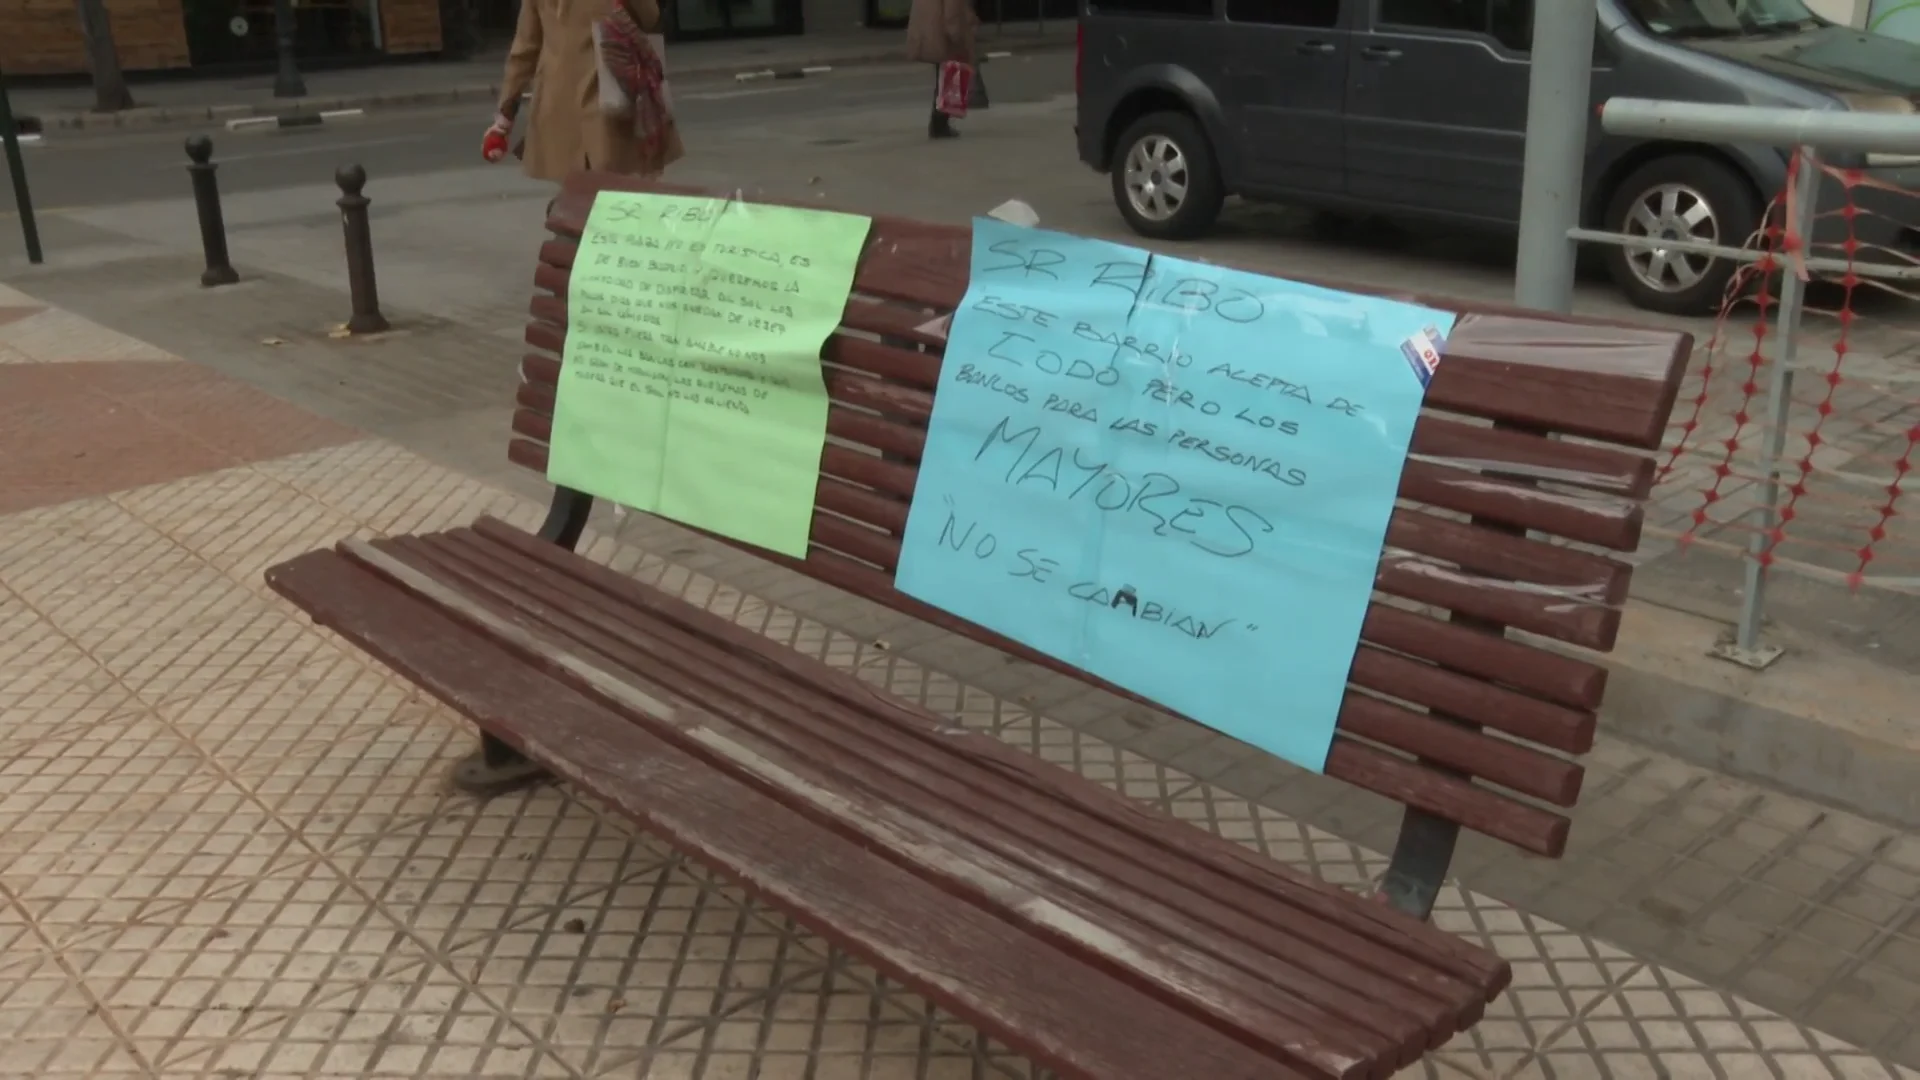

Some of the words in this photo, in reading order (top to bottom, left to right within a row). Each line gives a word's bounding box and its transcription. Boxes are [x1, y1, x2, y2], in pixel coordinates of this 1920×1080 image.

[982, 239, 1067, 281] SR
[1089, 261, 1264, 324] RIBO
[971, 295, 1059, 328] ESTE
[1073, 320, 1193, 369] BARRIO
[1207, 361, 1312, 403] ACEPTA
[1326, 399, 1366, 418] DE
[987, 331, 1120, 387] TODO
[1141, 378, 1221, 417] PERO
[1234, 410, 1299, 435] LOS
[955, 363, 1030, 403] BANCOS
[1042, 393, 1098, 422] PARA
[1109, 416, 1157, 443] LAS
[1168, 428, 1308, 487] PERSONAS
[974, 416, 1274, 558] MAYORES
[1008, 548, 1060, 583] SE
